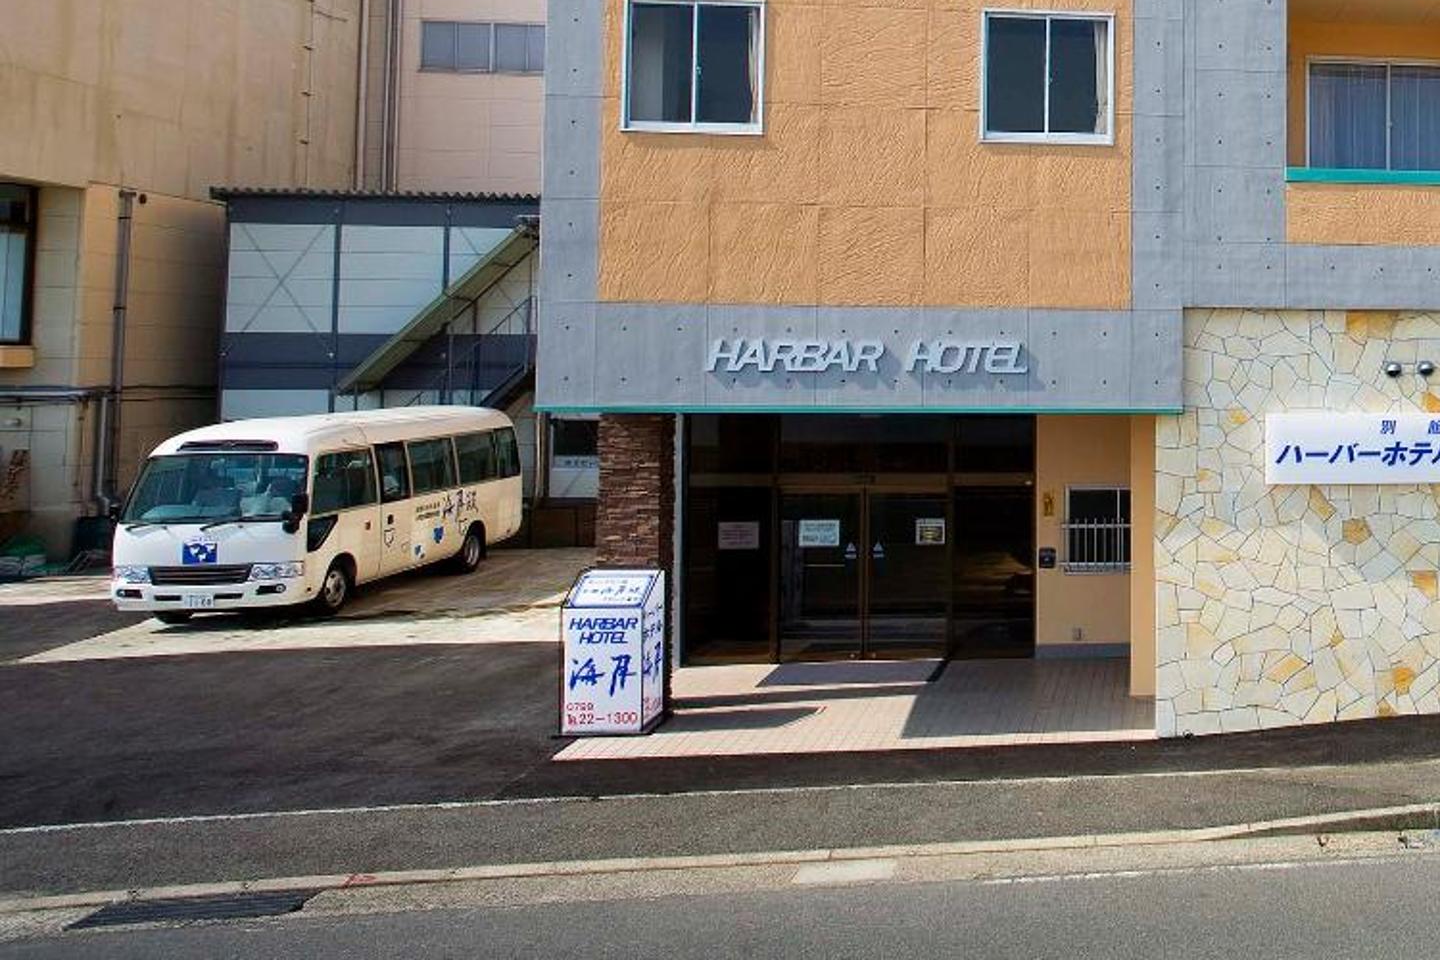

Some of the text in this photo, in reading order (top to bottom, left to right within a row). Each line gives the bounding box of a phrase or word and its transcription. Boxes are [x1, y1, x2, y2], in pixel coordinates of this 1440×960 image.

[706, 339, 1029, 374] HARBAR HOTEL
[569, 617, 639, 631] HARBAR
[579, 631, 629, 644] HOTEL
